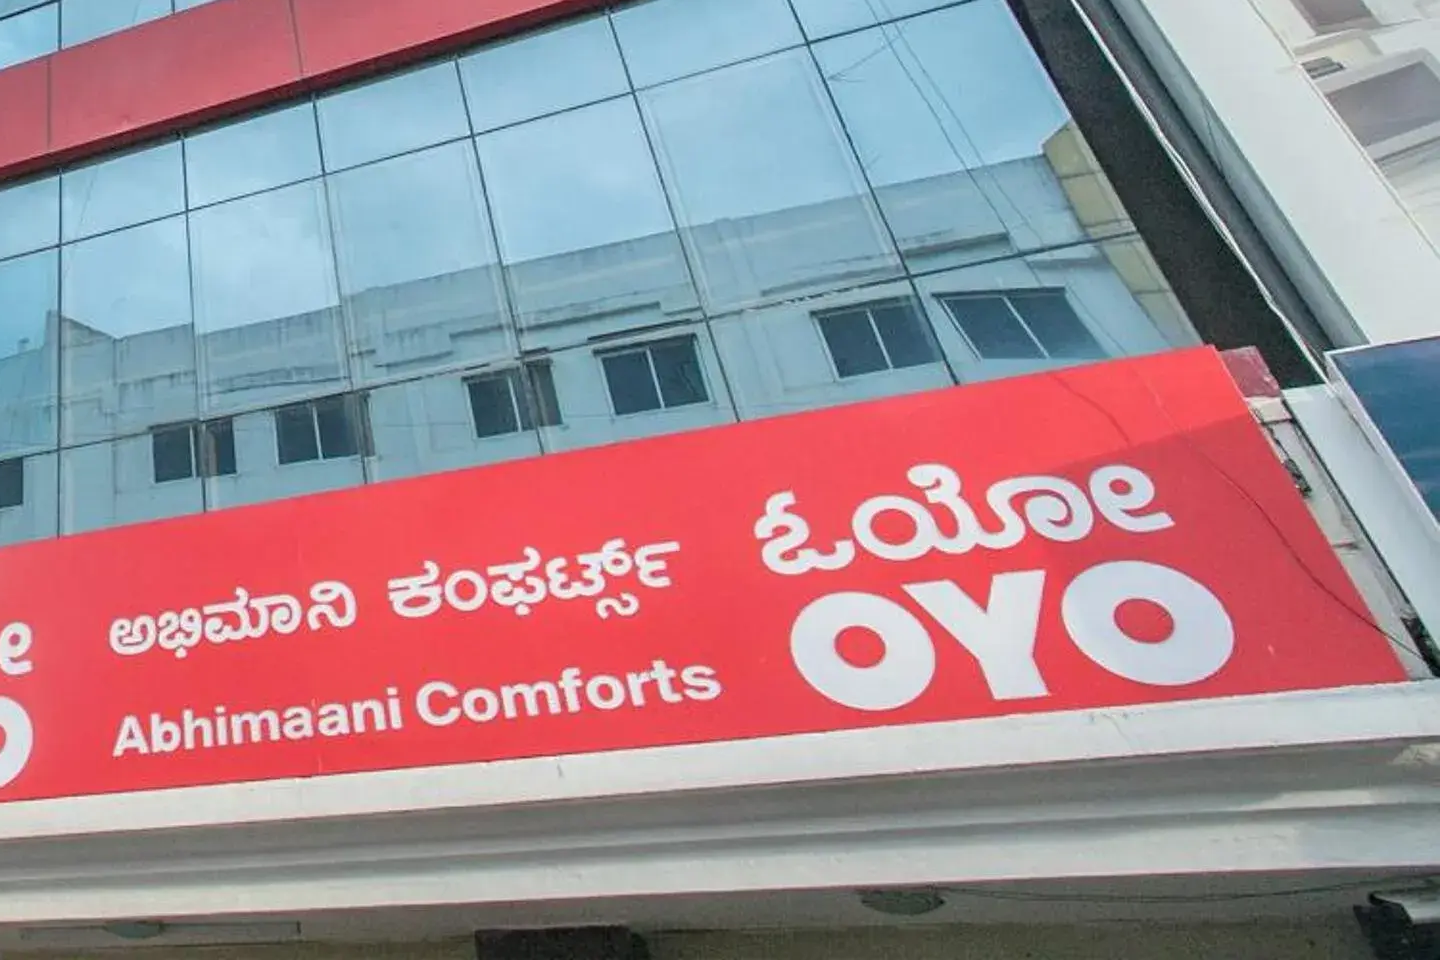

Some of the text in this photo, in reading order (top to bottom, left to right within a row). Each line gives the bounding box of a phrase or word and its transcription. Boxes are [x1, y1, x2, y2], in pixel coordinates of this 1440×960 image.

[753, 463, 1175, 575] ಓಯೋ
[109, 580, 357, 658] ಅಭಿಮಾನಿ
[791, 560, 1234, 711] OYO
[113, 659, 721, 757] Abhimaani Comforts
